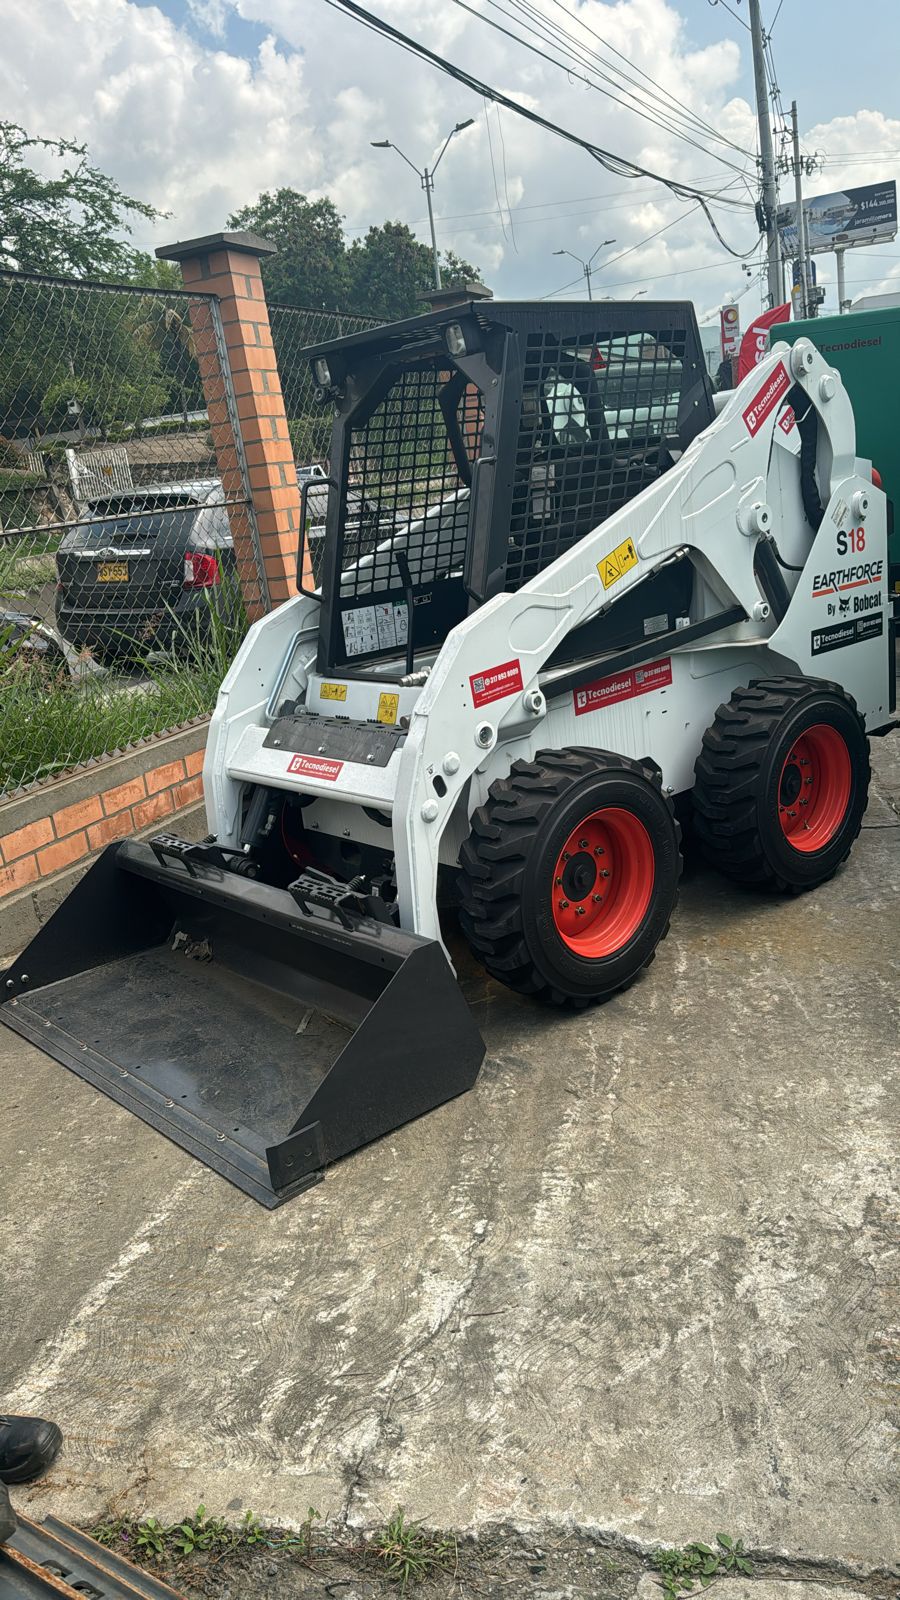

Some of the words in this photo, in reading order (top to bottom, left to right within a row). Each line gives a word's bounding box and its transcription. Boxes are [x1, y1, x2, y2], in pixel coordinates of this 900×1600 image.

[818, 335, 882, 353] Tecnodiesel
[753, 369, 786, 416] Tecnodiesel
[836, 526, 866, 556] S18
[812, 560, 883, 592] EARTHFORCE
[827, 603, 836, 617] By
[853, 590, 882, 614] Bobcat
[821, 626, 854, 643] Tecnodiesel
[588, 677, 632, 700] Tecnodiesel
[301, 760, 340, 773] Tecnodiesel
